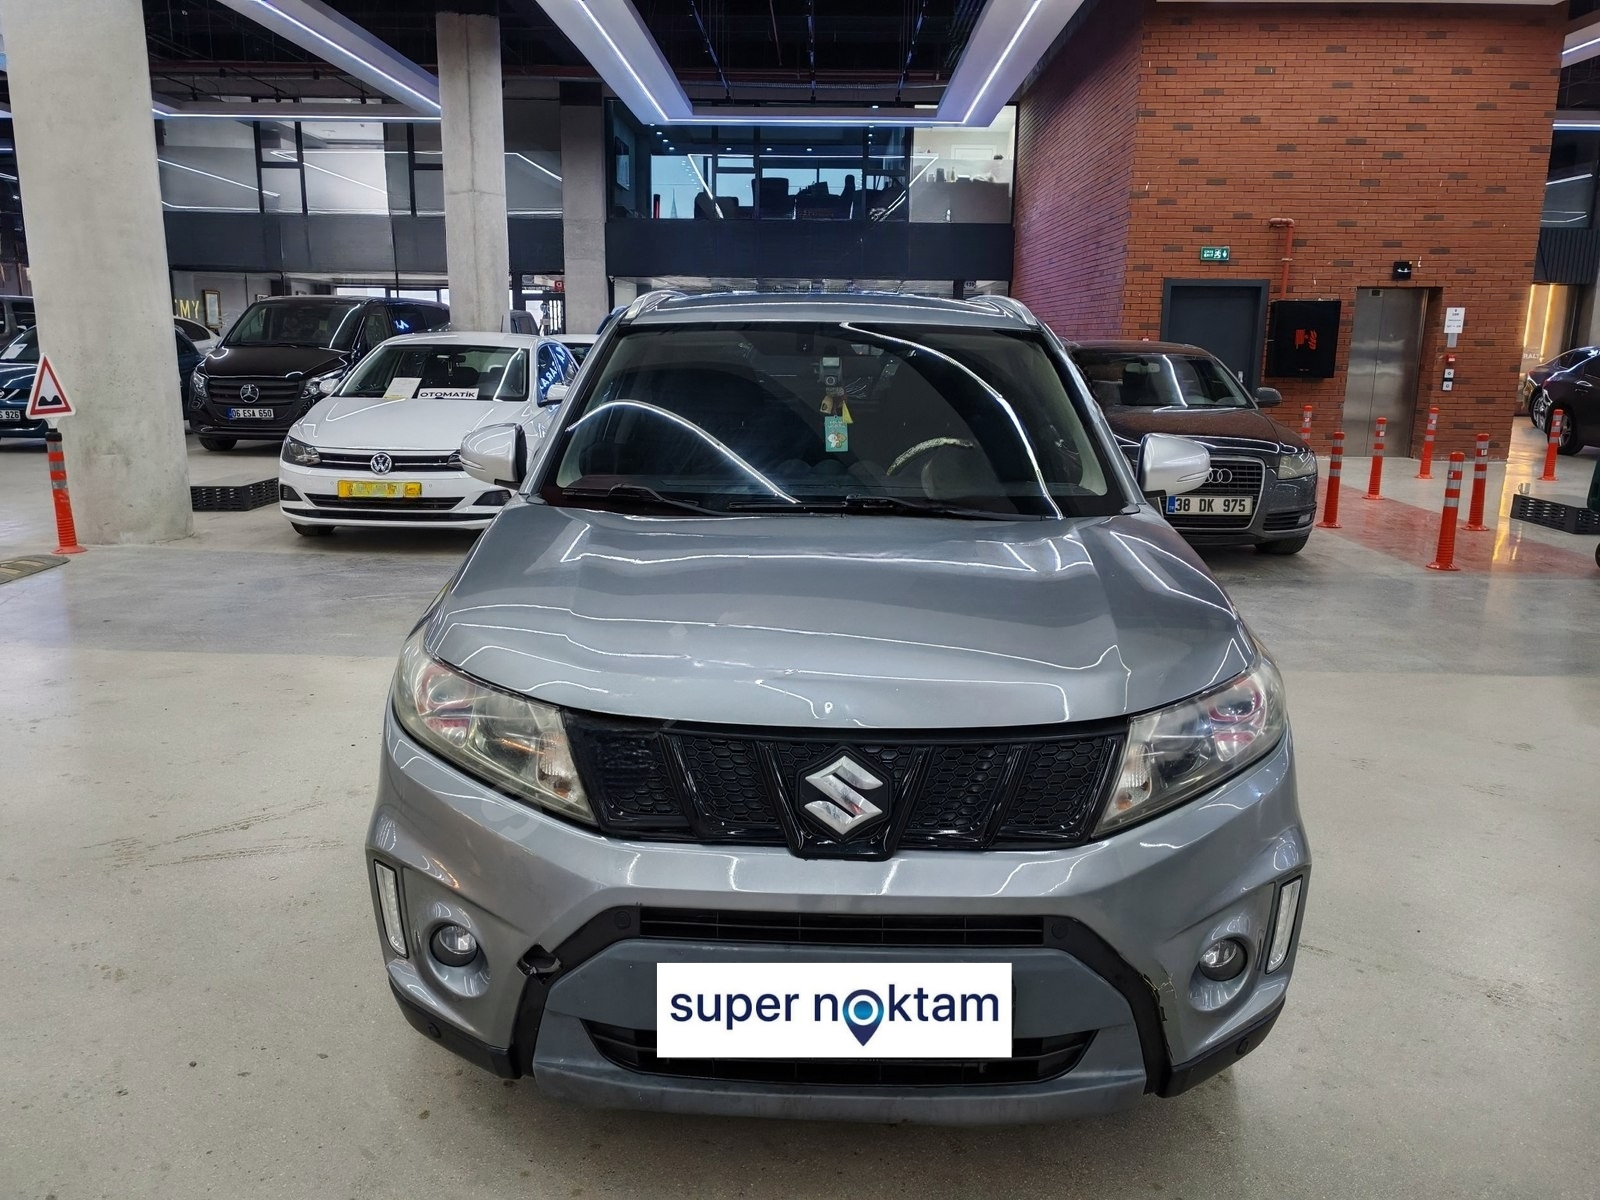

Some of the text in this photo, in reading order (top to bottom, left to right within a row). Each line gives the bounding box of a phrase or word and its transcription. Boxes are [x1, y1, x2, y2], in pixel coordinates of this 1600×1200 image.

[231, 409, 241, 418] 06
[1175, 498, 1191, 512] 38
[1199, 498, 1215, 512] DK
[1223, 498, 1246, 512] 975
